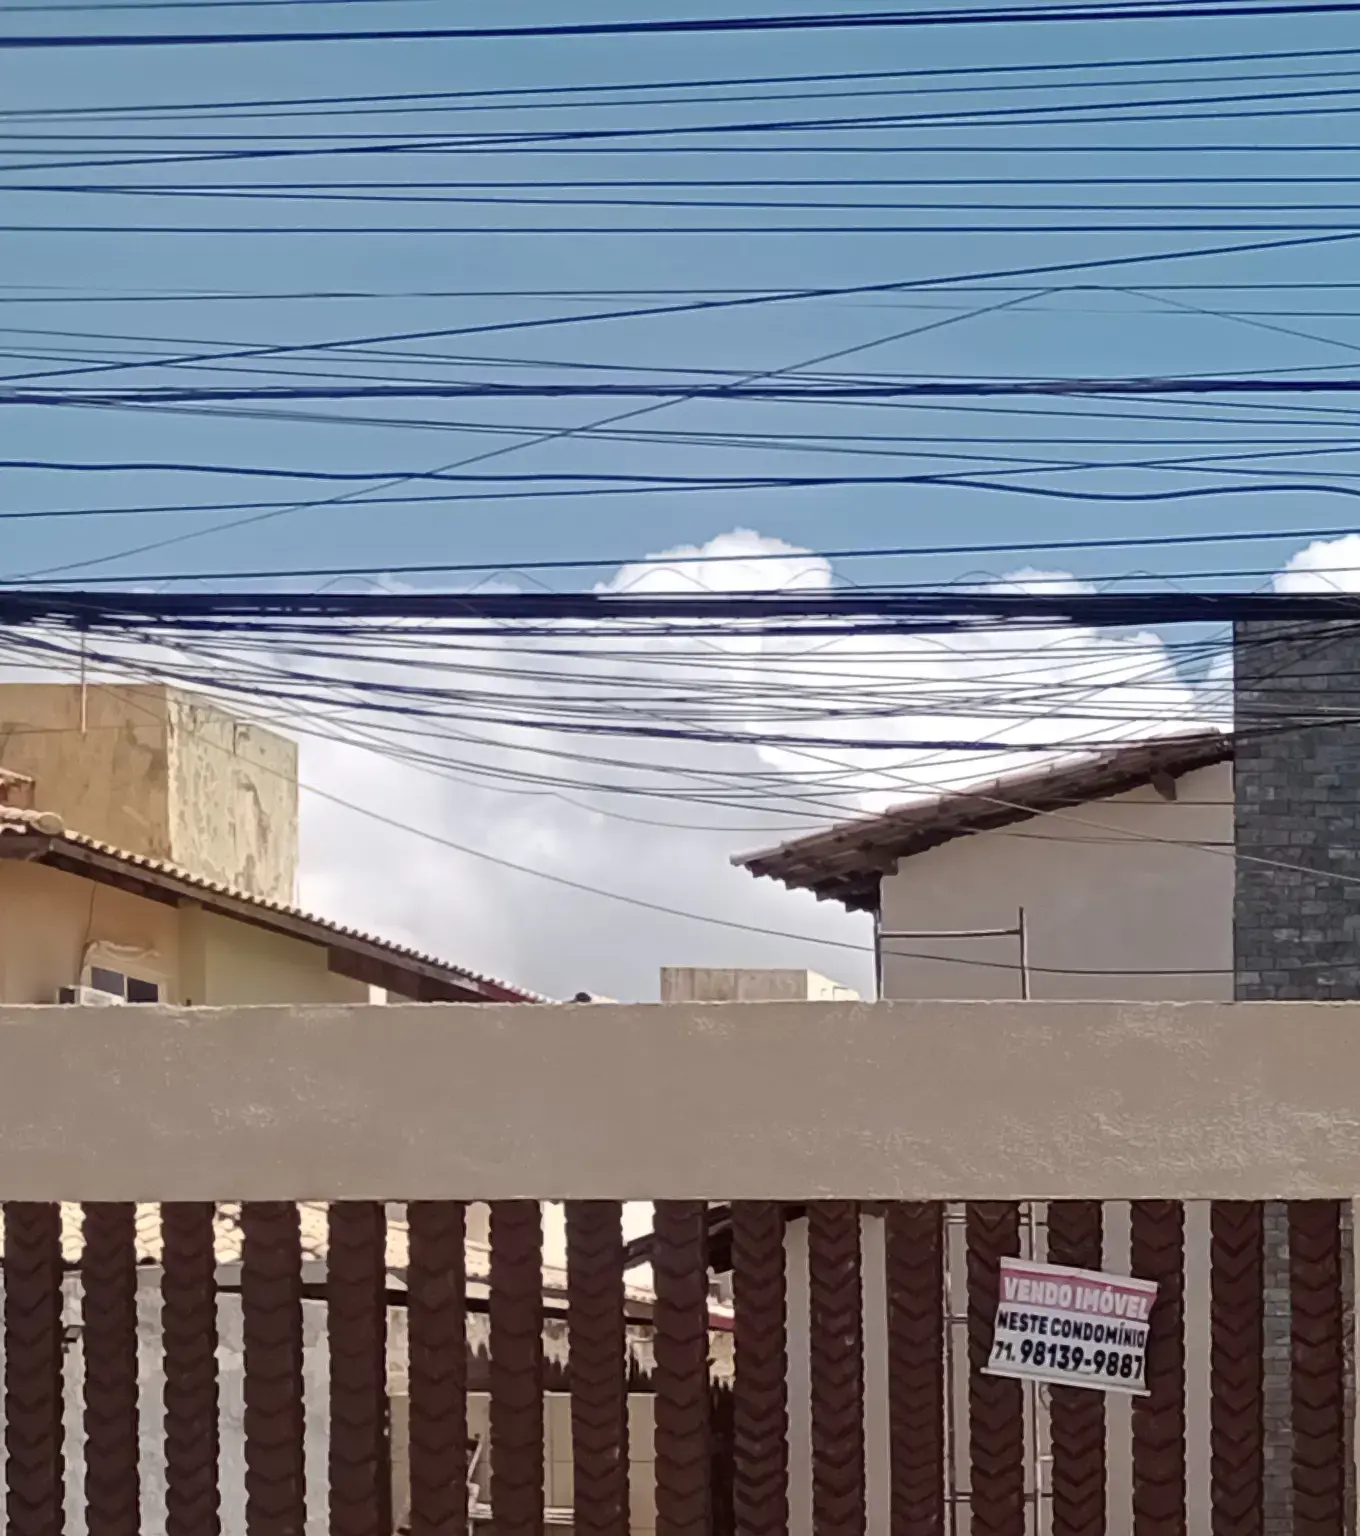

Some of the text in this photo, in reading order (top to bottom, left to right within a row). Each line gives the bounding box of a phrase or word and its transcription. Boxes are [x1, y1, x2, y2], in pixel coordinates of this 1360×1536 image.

[1004, 1277, 1148, 1319] VENDO IMÓVEL
[998, 1310, 1145, 1349] NESTE CONDOMÍNIO
[1020, 1339, 1143, 1379] 98139-9887
